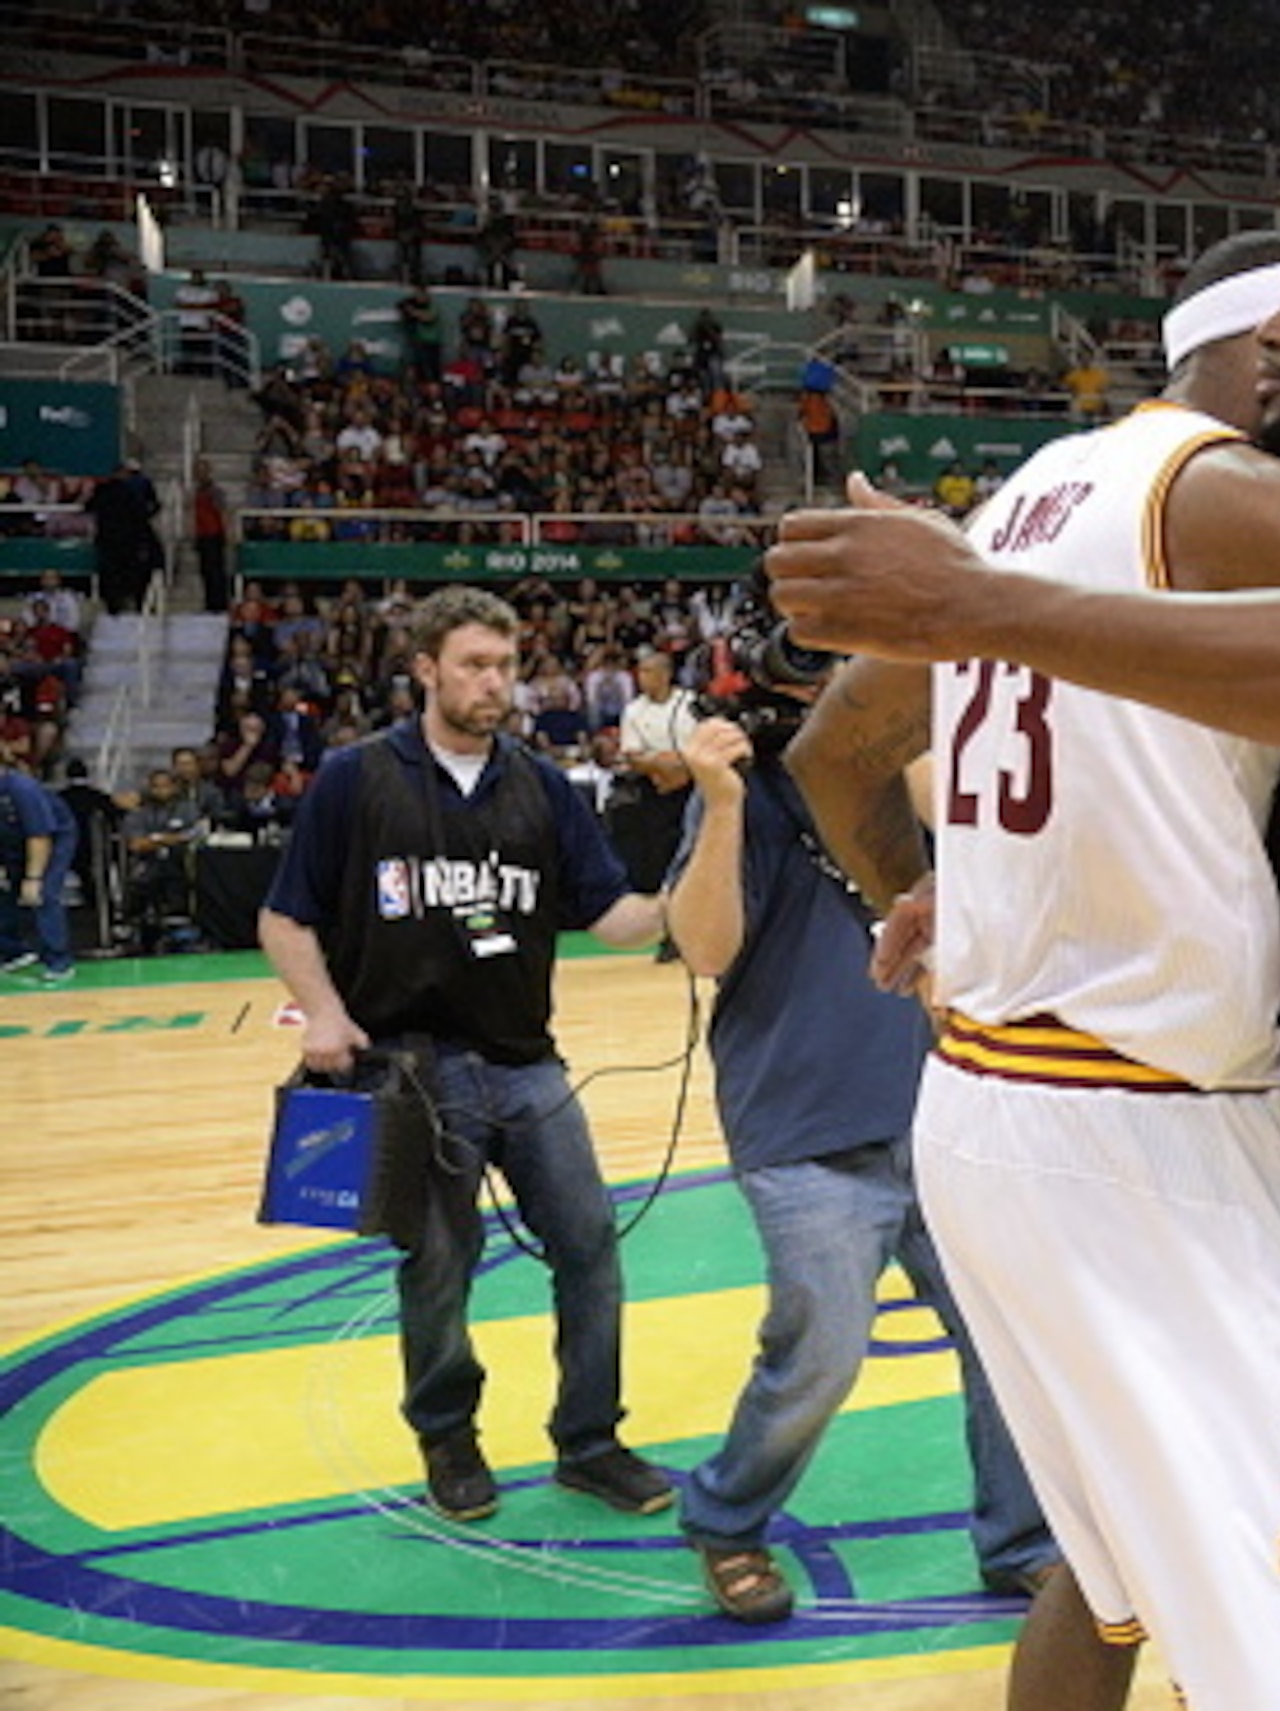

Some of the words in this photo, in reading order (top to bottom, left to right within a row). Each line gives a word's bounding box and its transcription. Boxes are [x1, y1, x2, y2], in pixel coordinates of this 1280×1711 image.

[485, 551, 527, 573] RIO
[530, 552, 581, 574] 2014
[946, 658, 1053, 837] 23
